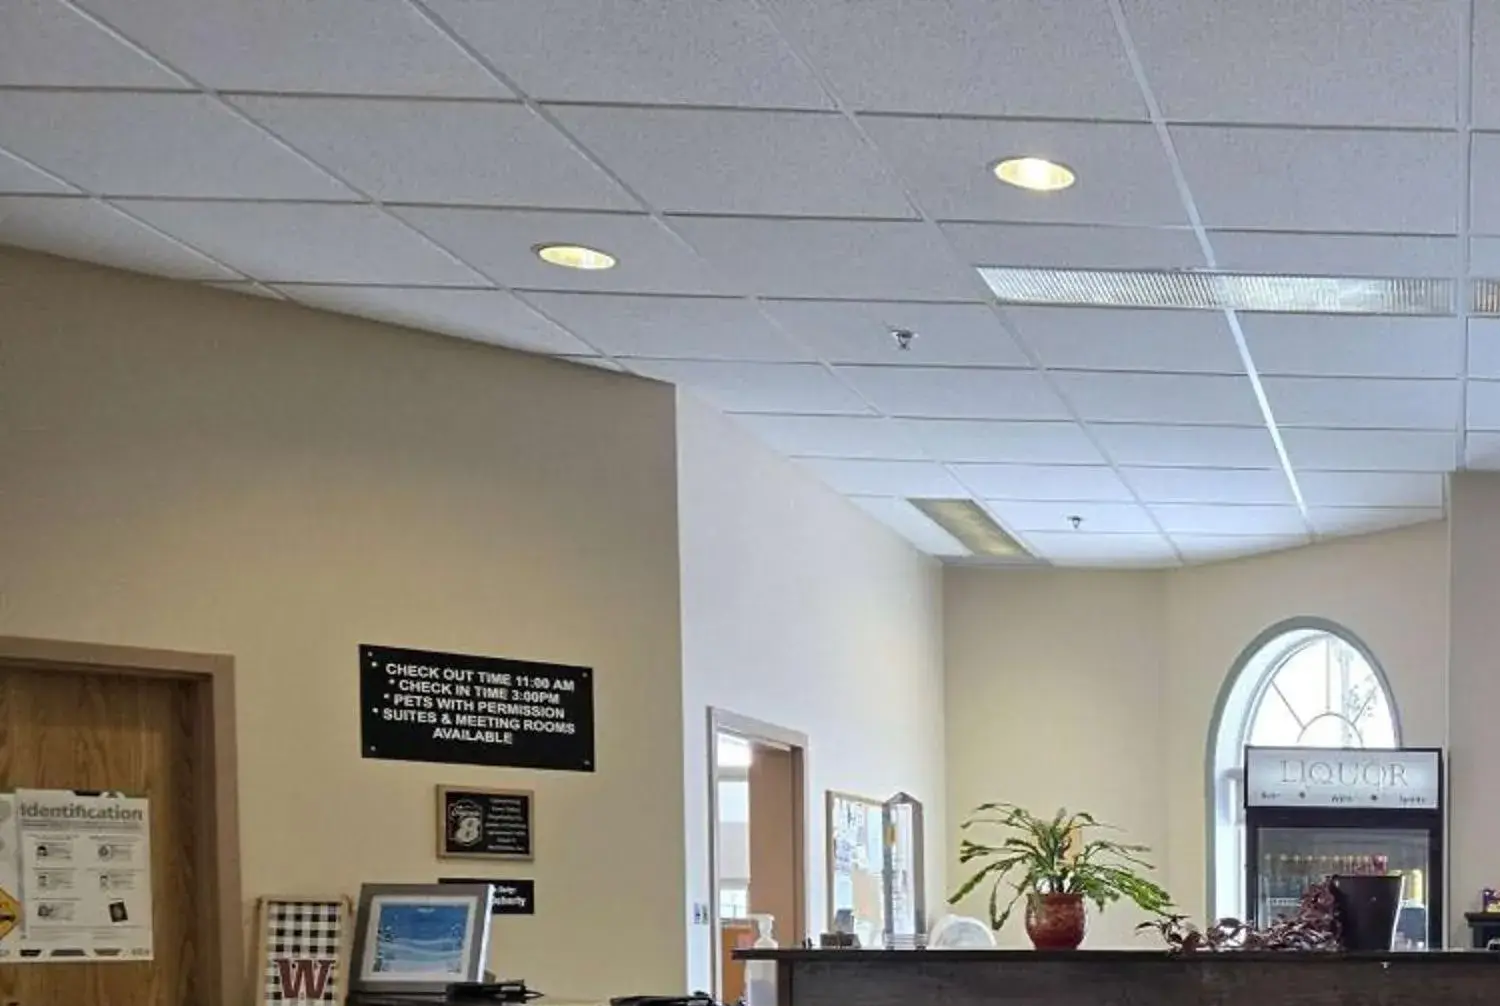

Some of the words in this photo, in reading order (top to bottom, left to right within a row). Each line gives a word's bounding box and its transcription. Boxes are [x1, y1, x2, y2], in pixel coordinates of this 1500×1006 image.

[385, 663, 440, 679] CHECK
[443, 668, 474, 683] OUT
[477, 671, 512, 687] TIME
[516, 676, 550, 690] 11:00
[552, 679, 575, 692] AM
[399, 680, 452, 695] CHECK
[455, 684, 470, 698] IN
[474, 686, 508, 701] TIME
[511, 689, 560, 705] 3:00PM
[393, 694, 433, 708] PETS
[436, 697, 475, 712] WITH
[477, 701, 566, 719] PERMISSION
[383, 709, 437, 724] SUITES
[441, 713, 452, 725] &
[455, 714, 521, 731] MEETING
[523, 720, 576, 735] ROOMS
[432, 727, 513, 745] AVAILABLE
[1279, 760, 1409, 788] LIQUOR
[19, 802, 143, 820] Identification
